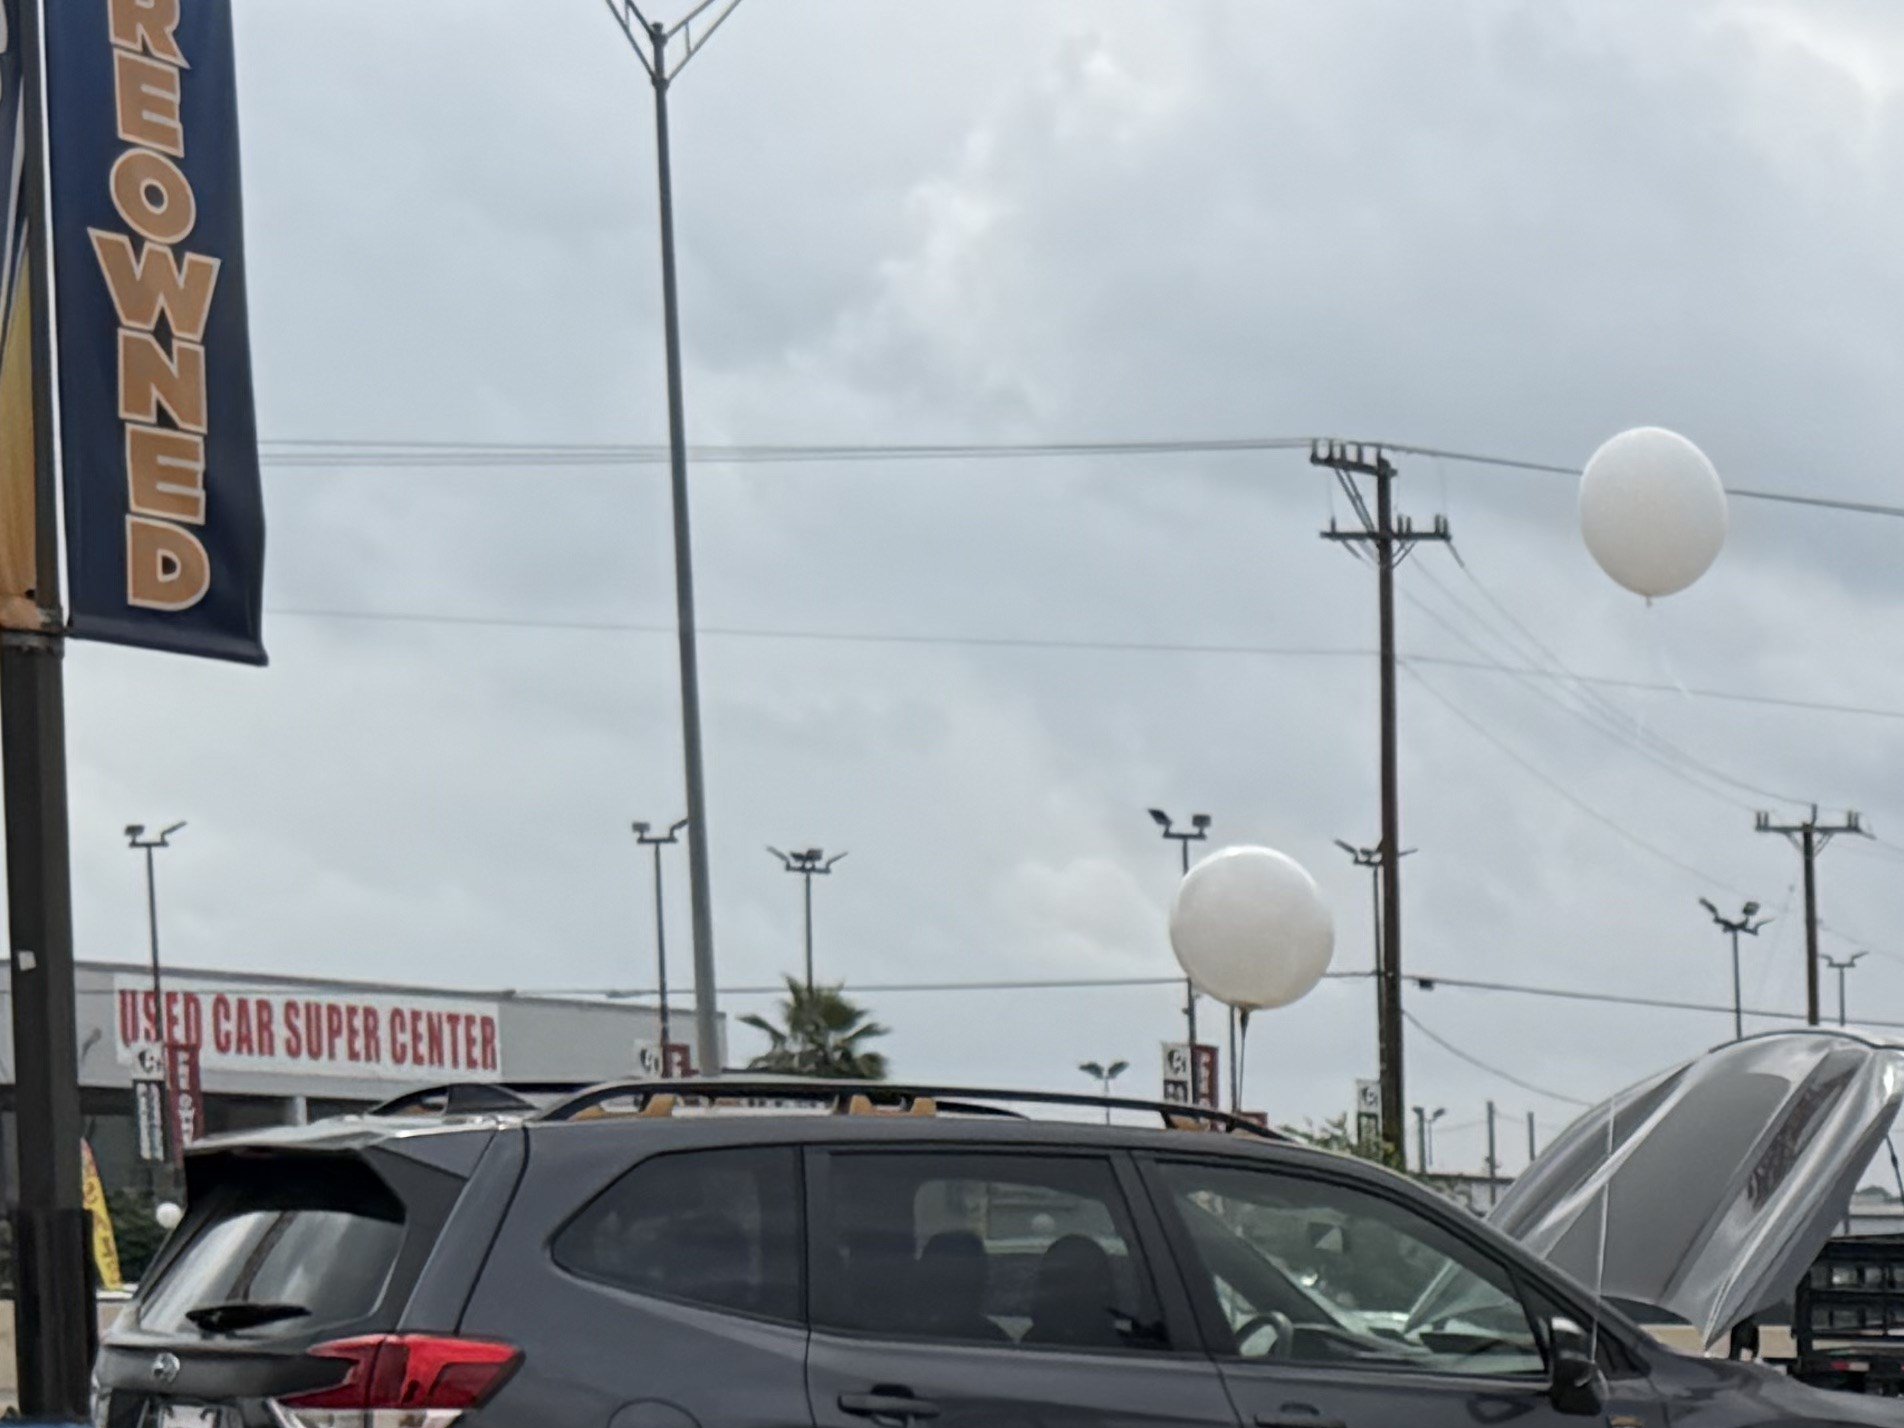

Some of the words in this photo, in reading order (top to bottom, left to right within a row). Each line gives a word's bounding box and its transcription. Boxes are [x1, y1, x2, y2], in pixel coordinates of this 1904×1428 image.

[119, 989, 202, 1049] USED
[212, 993, 275, 1056] CAR
[284, 1000, 383, 1062] SUPER
[390, 1007, 498, 1071] CENTER
